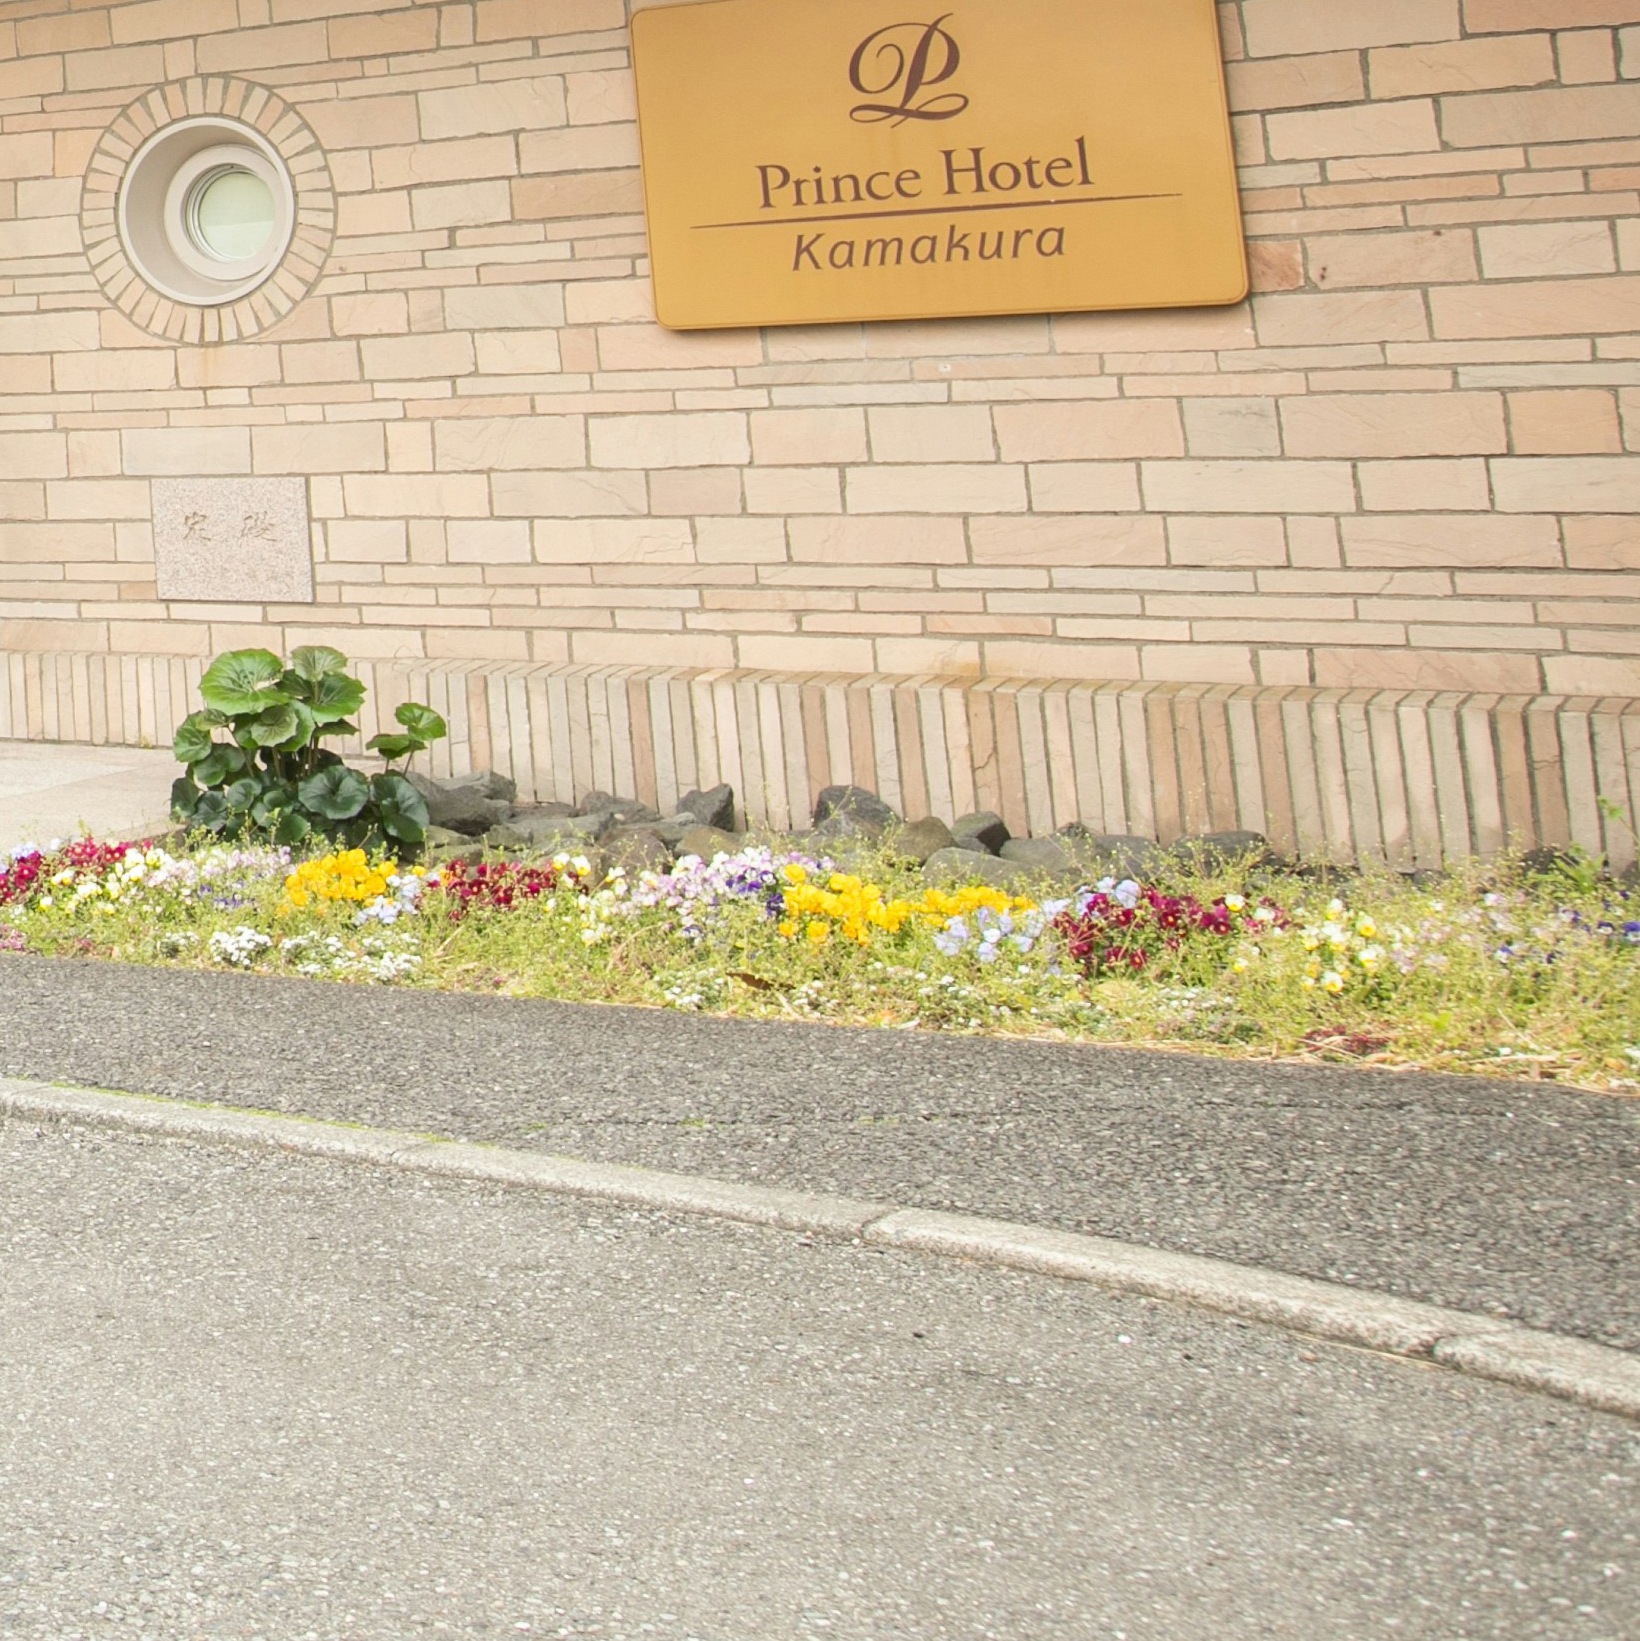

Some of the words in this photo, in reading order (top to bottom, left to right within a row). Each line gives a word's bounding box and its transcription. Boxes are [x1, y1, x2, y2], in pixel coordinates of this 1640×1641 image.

[755, 163, 921, 210] Prince
[941, 135, 1095, 197] Hotel
[792, 223, 1066, 272] Kamakura
